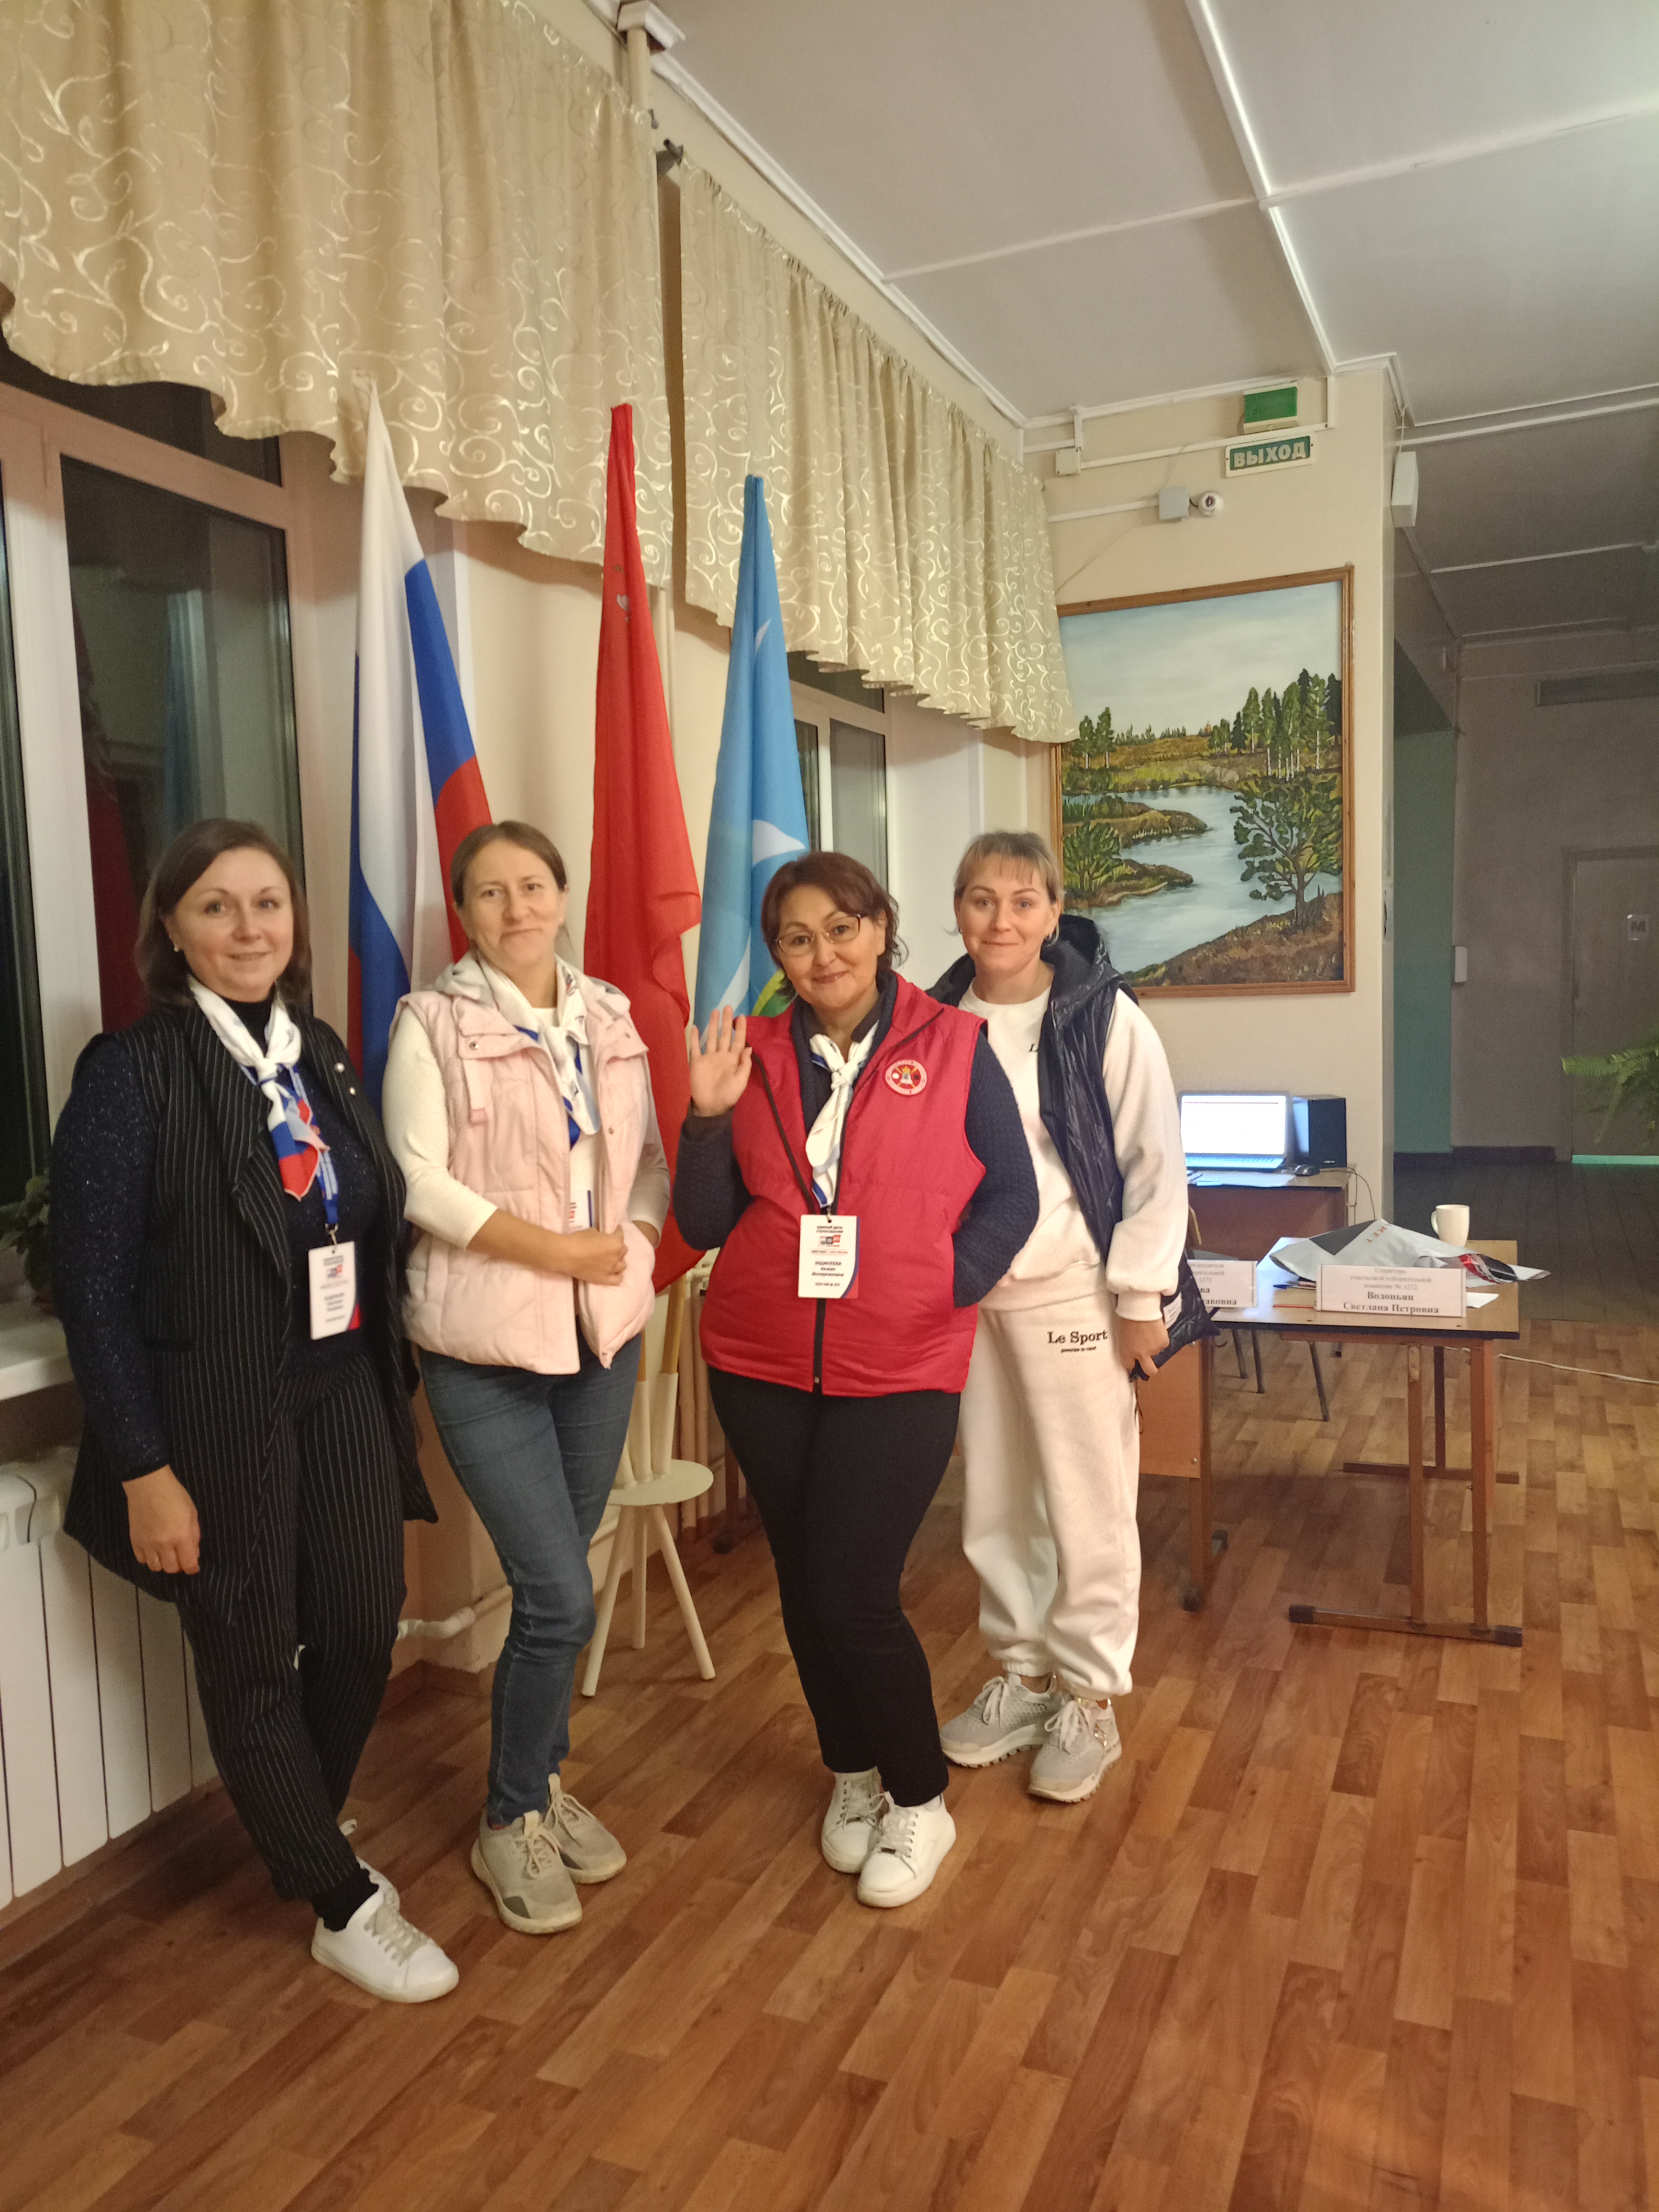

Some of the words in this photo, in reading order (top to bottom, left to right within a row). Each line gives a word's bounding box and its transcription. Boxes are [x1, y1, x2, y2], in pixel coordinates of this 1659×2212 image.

[1234, 442, 1306, 468] ВЫХОД
[1366, 1226, 1387, 1244] КЕТ
[1343, 1302, 1389, 1312] Светлана
[1392, 1304, 1439, 1315] Петровна
[1047, 1331, 1066, 1343] Le
[1070, 1329, 1108, 1345] Sport
